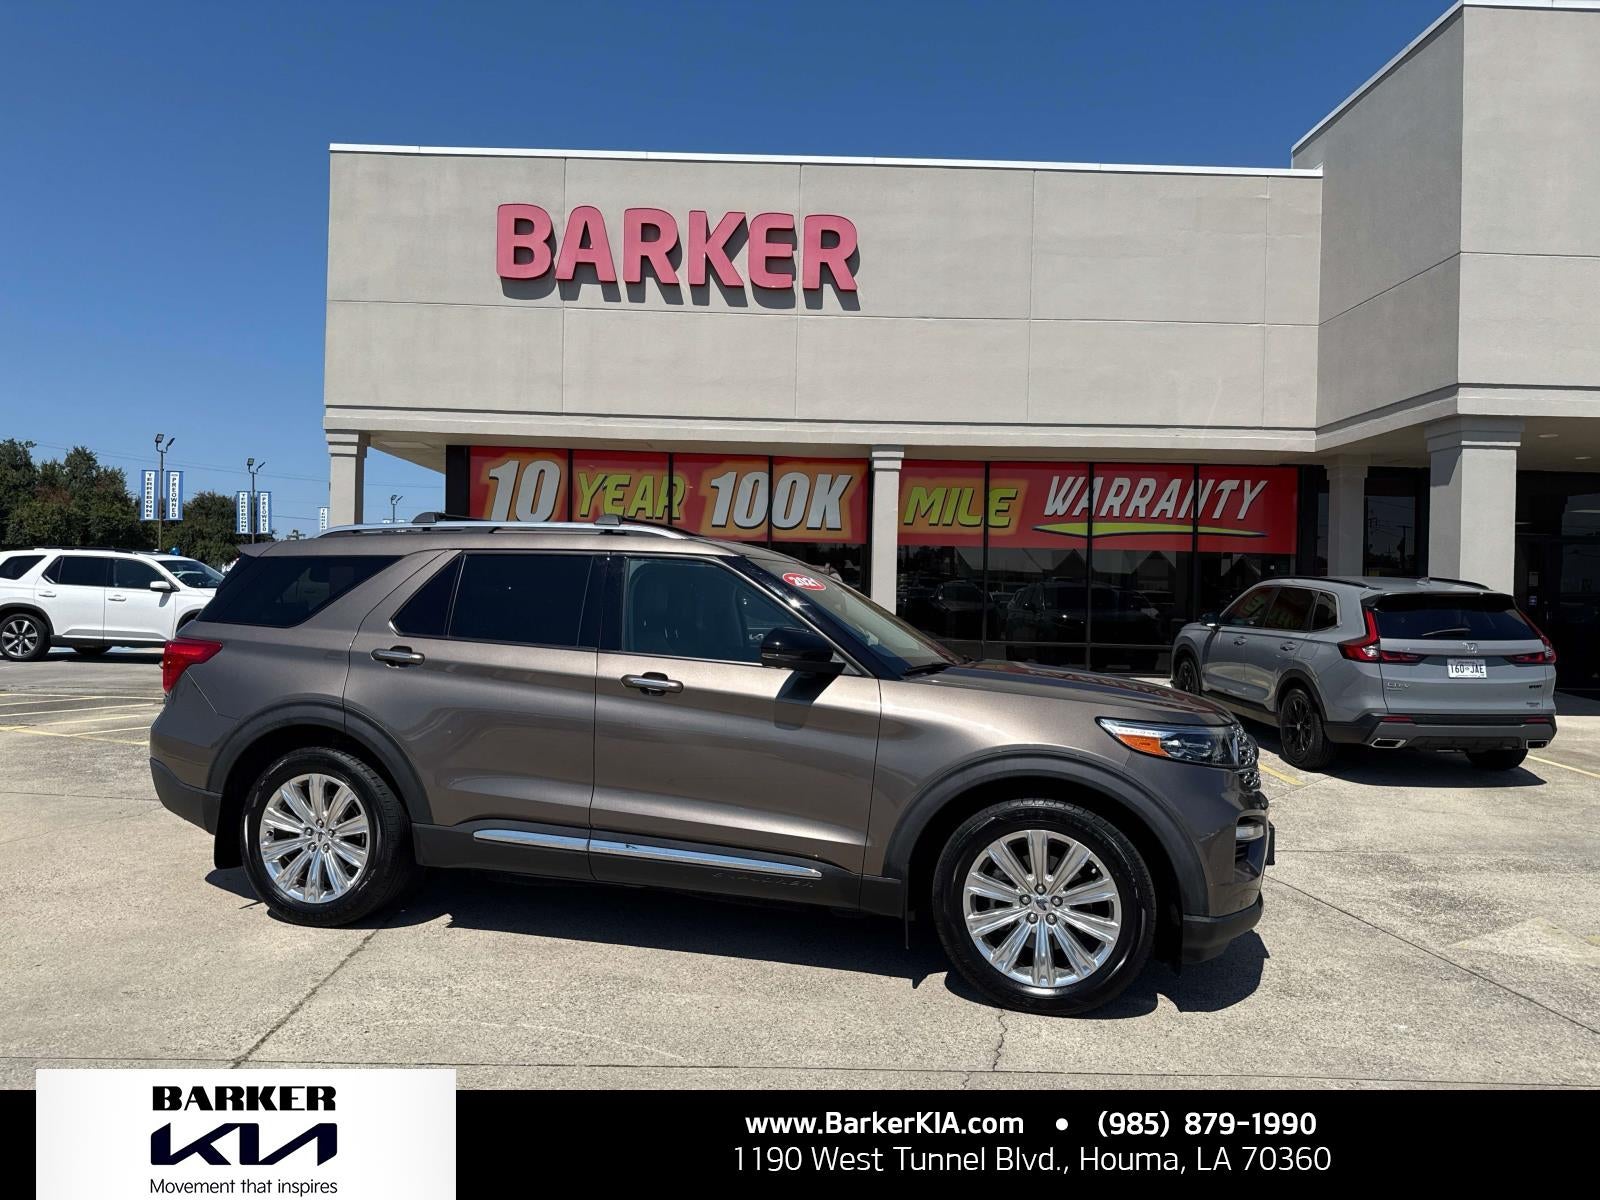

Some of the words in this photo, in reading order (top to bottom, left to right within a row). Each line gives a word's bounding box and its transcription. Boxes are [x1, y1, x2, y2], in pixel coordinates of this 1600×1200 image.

[496, 203, 858, 292] BARKER
[145, 472, 153, 518] TERREBONNE
[489, 460, 561, 521] 10
[578, 472, 686, 520] YEAR
[710, 470, 853, 530] 100K
[903, 486, 1018, 528] MILE
[1044, 475, 1268, 520] WARRANTY
